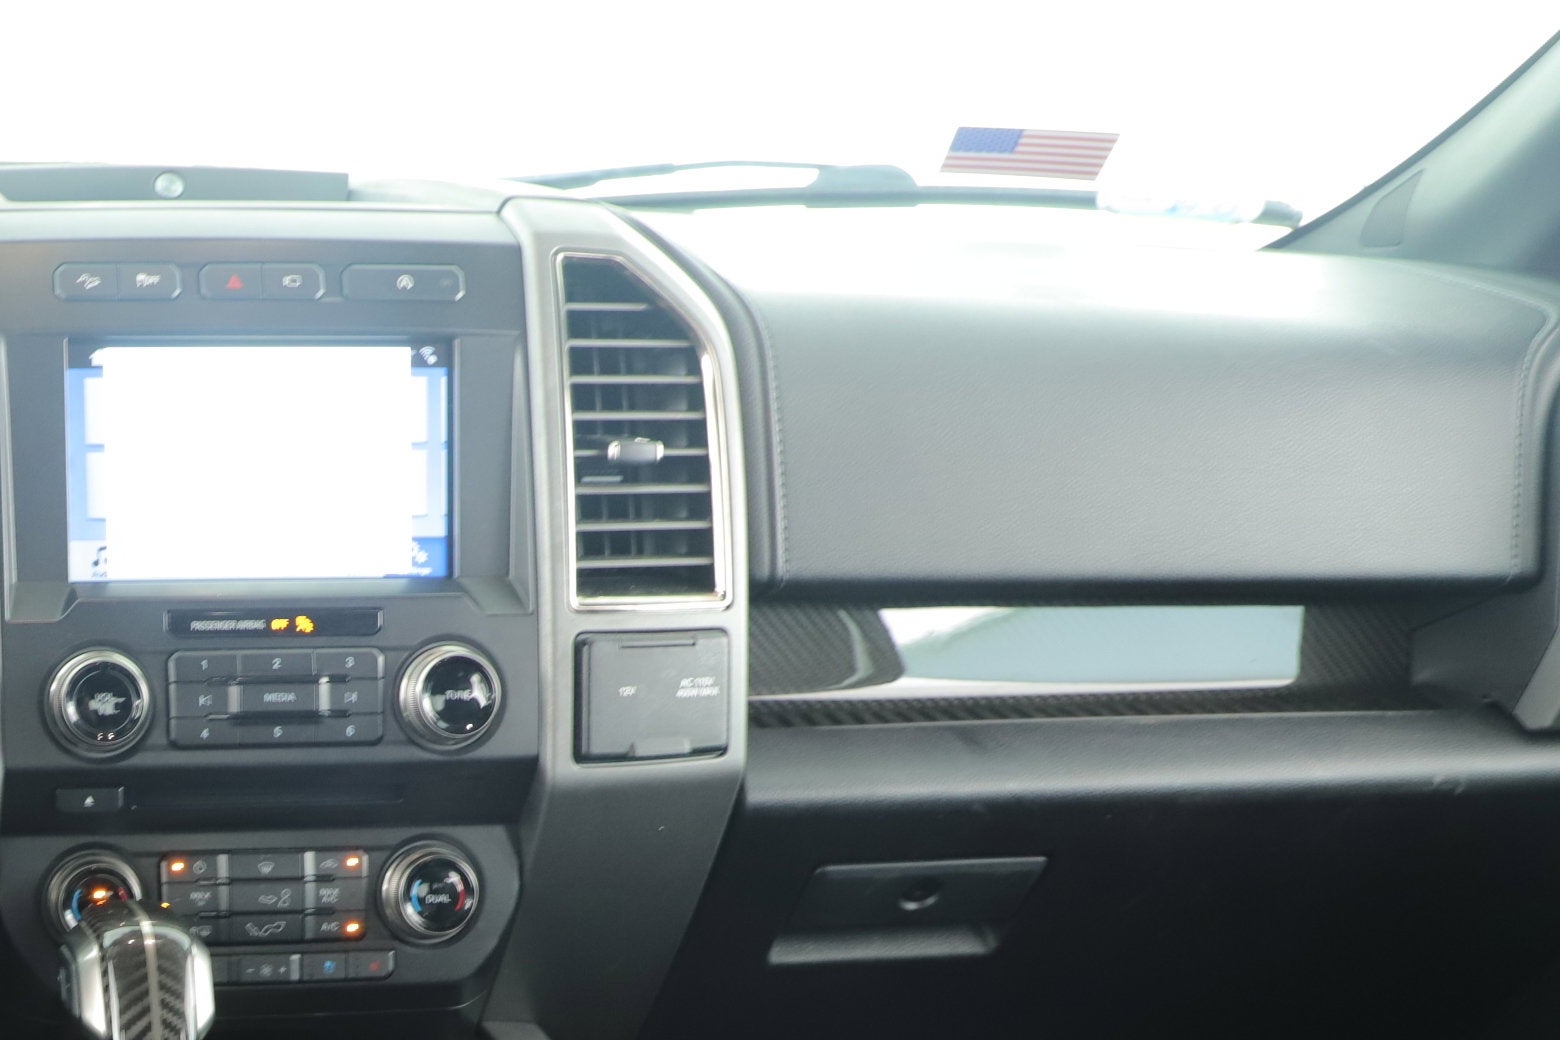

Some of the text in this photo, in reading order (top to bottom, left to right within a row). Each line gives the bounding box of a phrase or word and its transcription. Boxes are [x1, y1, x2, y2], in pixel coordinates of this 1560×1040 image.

[271, 618, 290, 630] OFF
[272, 657, 282, 670] 2
[345, 656, 355, 668] 3
[263, 692, 297, 704] MEDIA
[200, 727, 210, 740] 4
[273, 726, 283, 738] 5
[346, 725, 356, 738] 6
